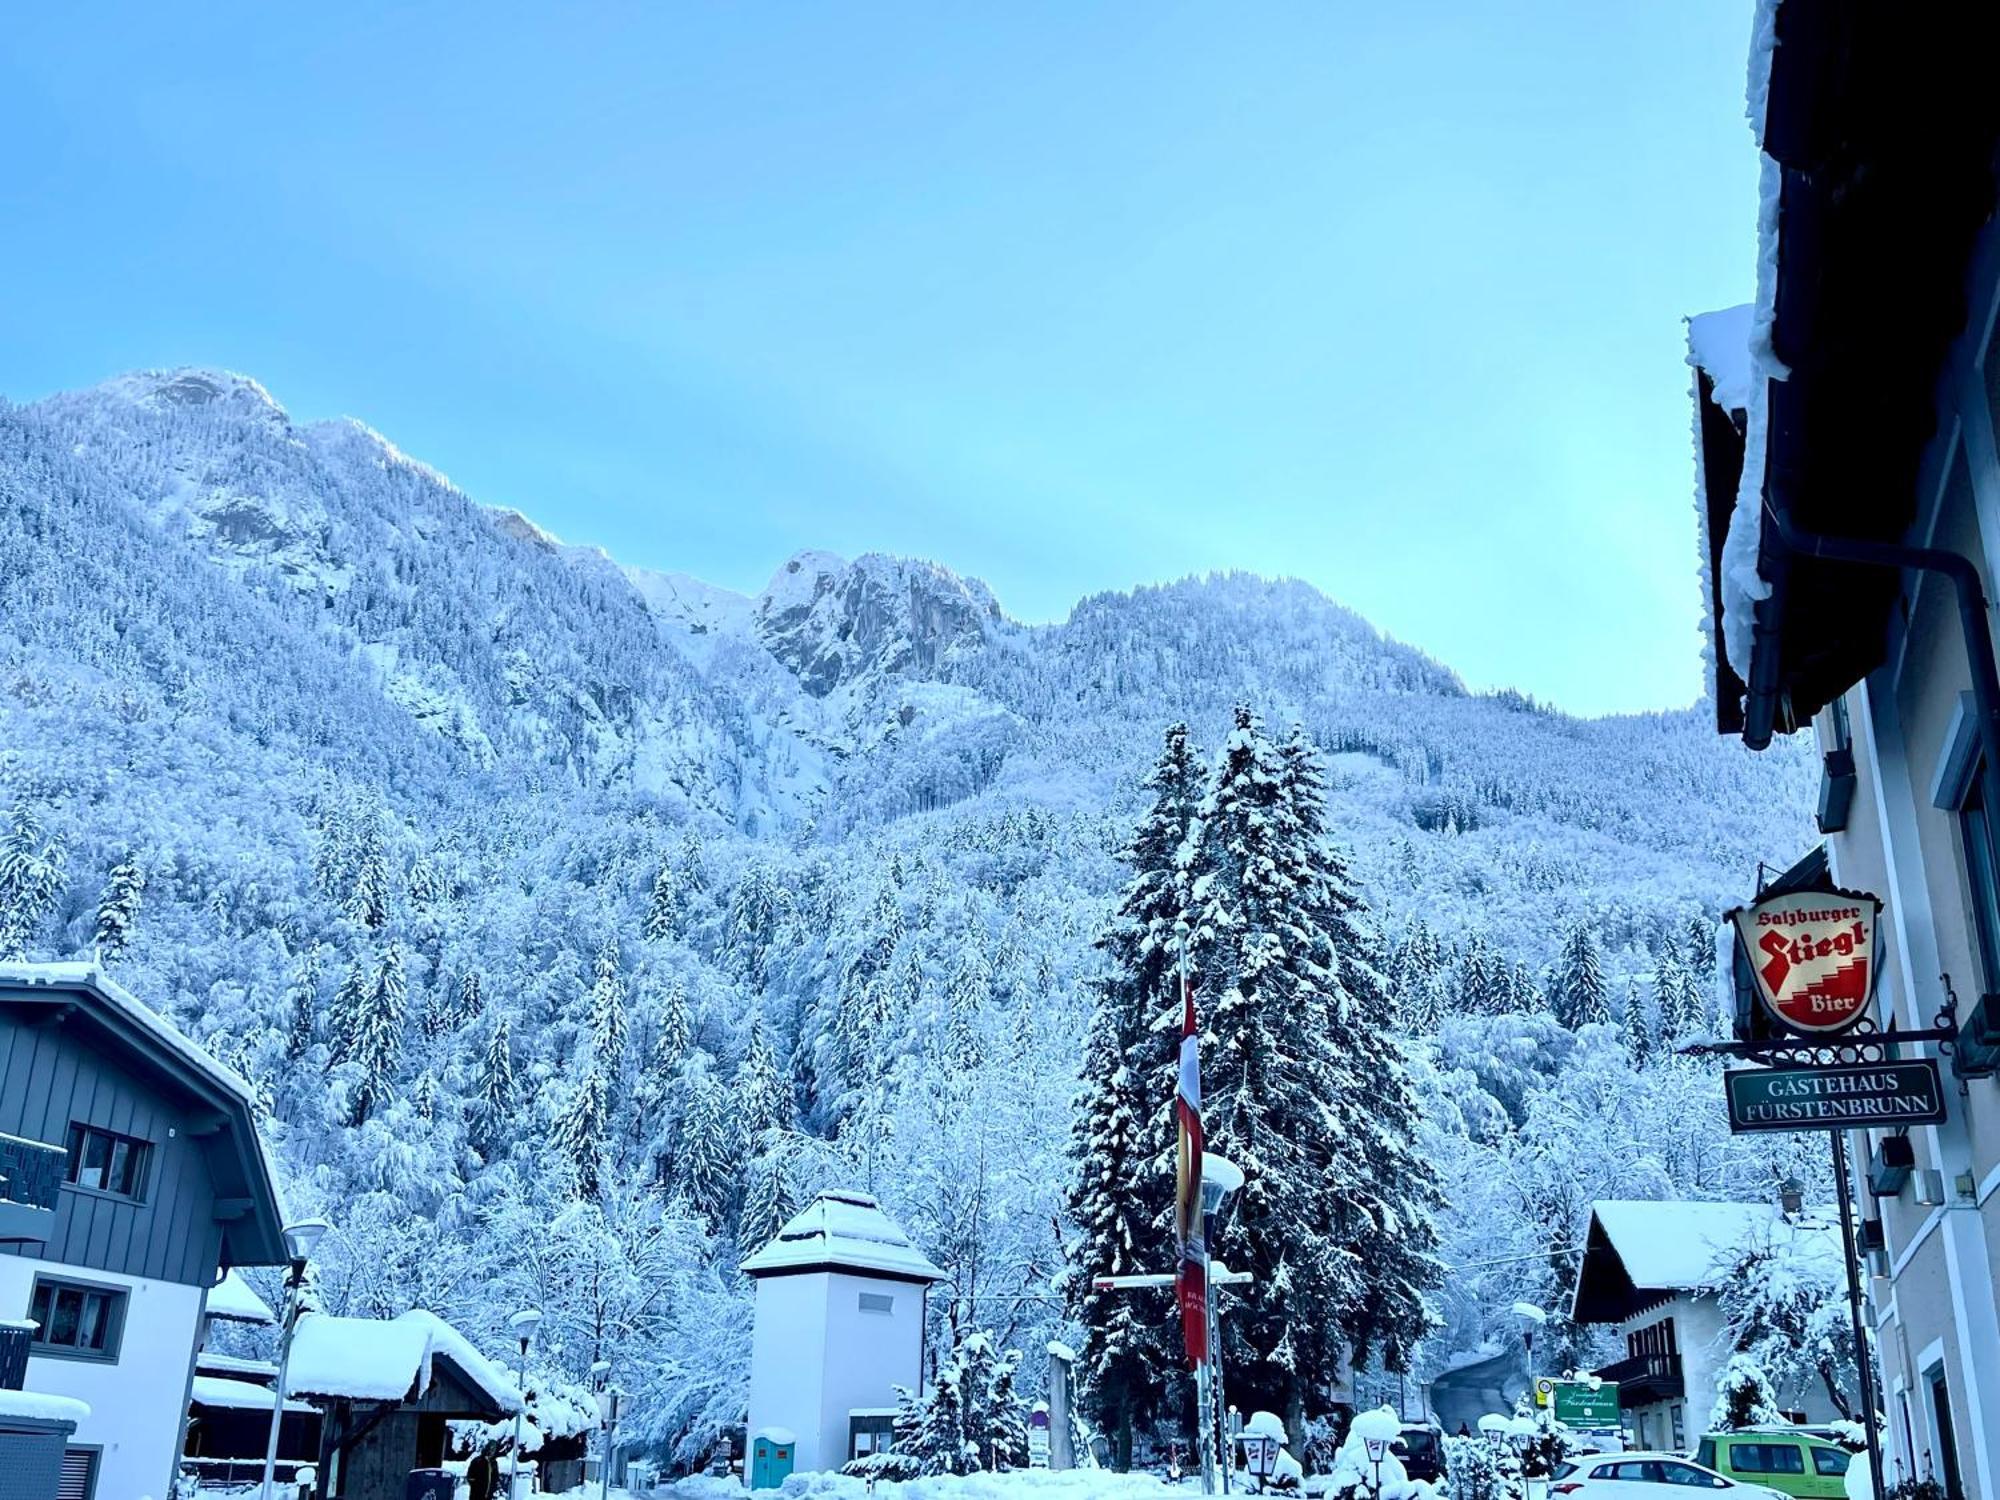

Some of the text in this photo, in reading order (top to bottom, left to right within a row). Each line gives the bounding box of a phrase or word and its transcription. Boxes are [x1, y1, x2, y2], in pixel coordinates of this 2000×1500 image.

[1757, 908, 1860, 926] Salzburger
[1810, 993, 1856, 1012] Bier
[1767, 1073, 1899, 1097] GÄSTEHAUS
[1746, 1095, 1929, 1121] FÜRSTENBRUNN
